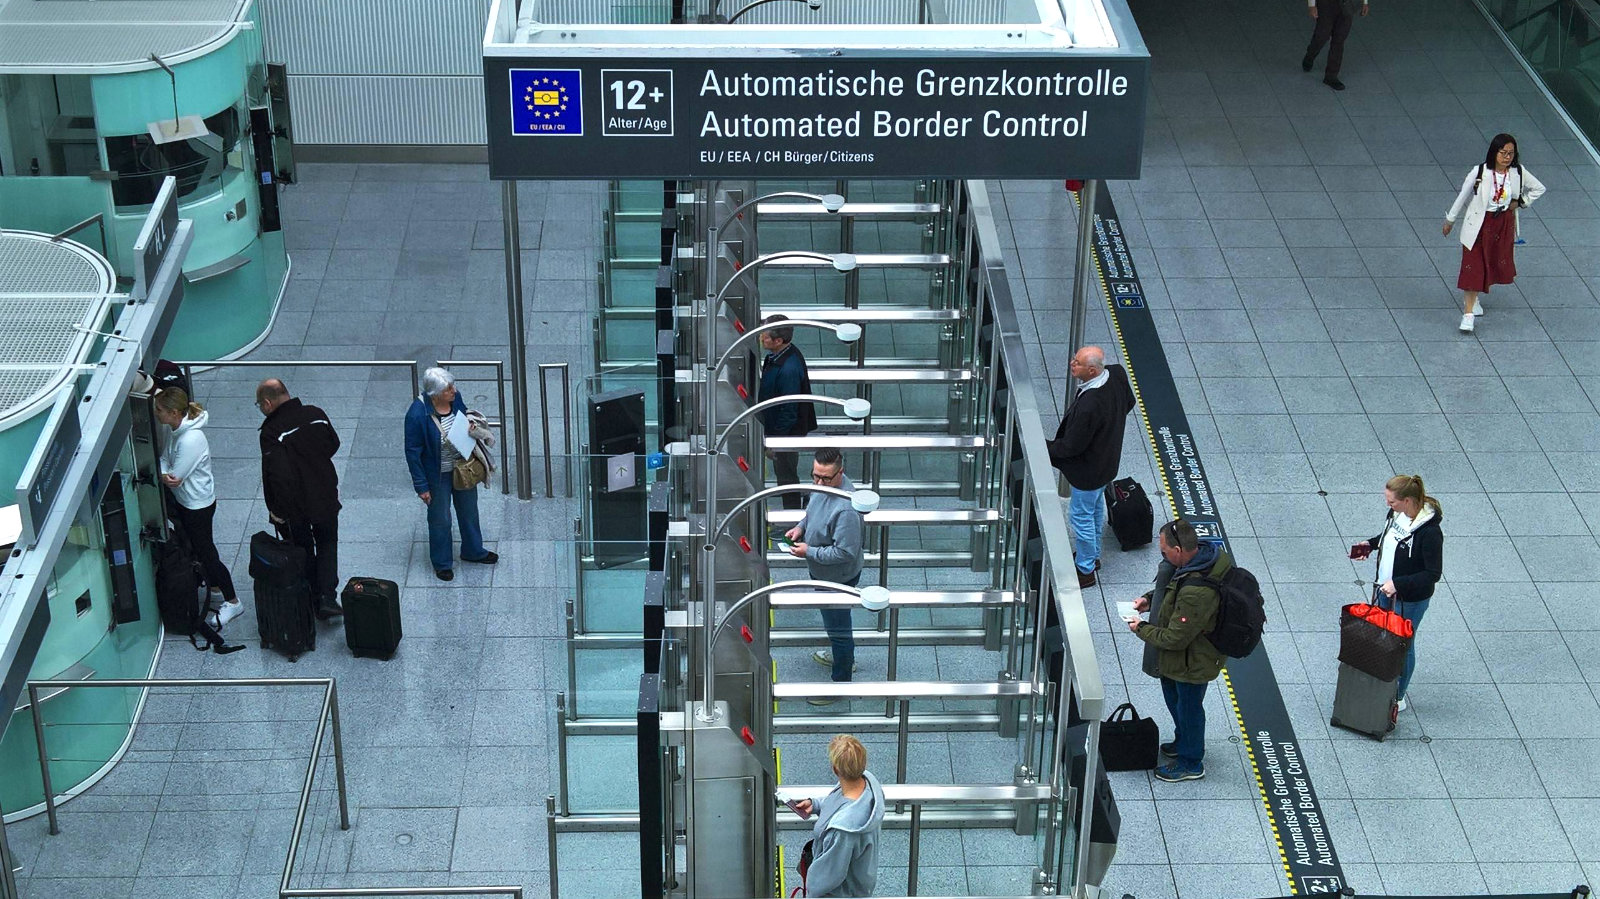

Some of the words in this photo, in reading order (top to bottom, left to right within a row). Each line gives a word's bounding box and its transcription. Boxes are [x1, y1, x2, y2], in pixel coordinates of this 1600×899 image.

[610, 80, 664, 110] 12+
[700, 68, 904, 97] Automatische
[916, 68, 1128, 97] Grenzkontrolle
[608, 116, 668, 131] Alter/Age
[700, 110, 861, 138] Automated
[873, 110, 972, 138] Border
[982, 110, 1088, 138] Control
[700, 151, 716, 162] EU
[727, 151, 751, 162] EEA
[764, 151, 780, 162] CH
[1105, 218, 1120, 236] Control
[1112, 236, 1126, 252] Border
[1115, 252, 1134, 278] Automated
[1117, 284, 1129, 294] 12+
[1159, 427, 1182, 470] Grenzkontrolle
[1176, 434, 1194, 456] Control
[1186, 457, 1202, 479] Border
[1174, 471, 1197, 516] Automatische
[1190, 480, 1215, 516] Automated
[1195, 524, 1209, 536] 12+
[1257, 731, 1288, 796] Grenzkontrolle
[1278, 742, 1302, 774] Control
[1293, 777, 1315, 809] Border
[1279, 798, 1312, 866] Automatische
[1302, 813, 1334, 866] Automated
[1311, 879, 1328, 894] 2+
